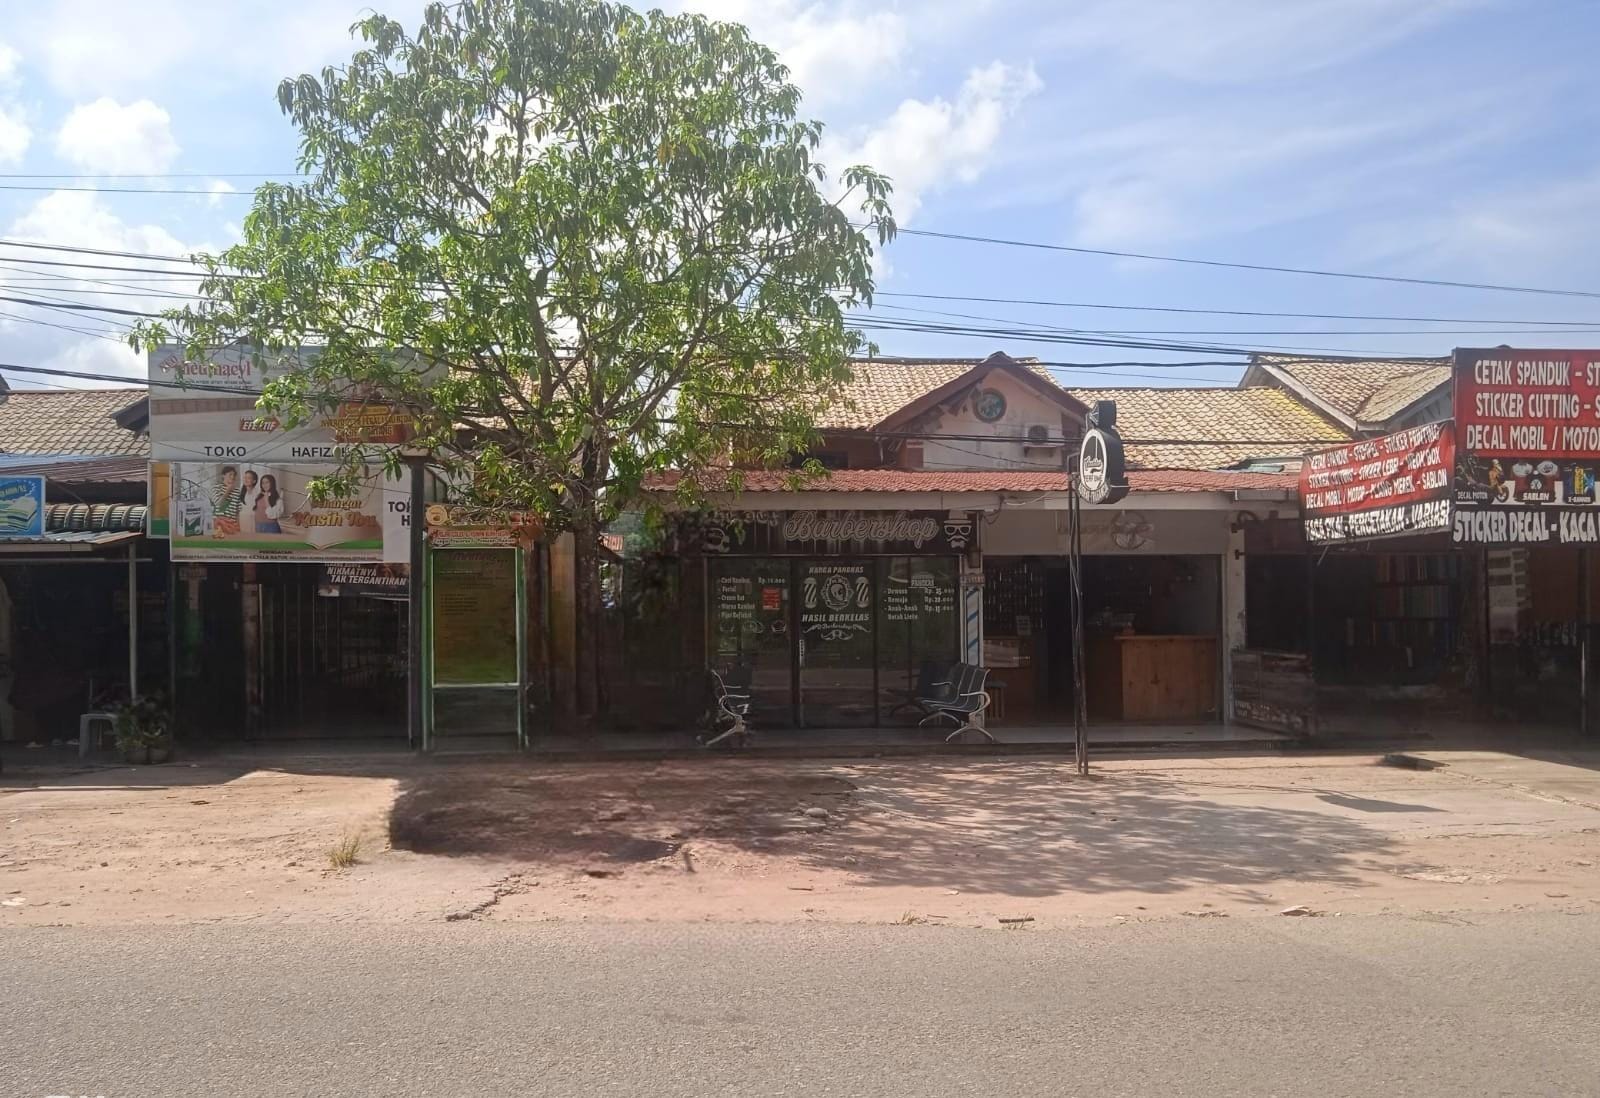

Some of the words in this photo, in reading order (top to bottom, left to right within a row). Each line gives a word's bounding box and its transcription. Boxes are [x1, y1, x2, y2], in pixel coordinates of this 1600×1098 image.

[1475, 360, 1512, 385] CETAK
[1517, 361, 1570, 386] SPANDUK
[1476, 393, 1524, 417] STICKER
[1528, 394, 1579, 418] CUTTING
[242, 420, 275, 430] EFETIF
[1466, 425, 1506, 449] DECAL
[1510, 425, 1547, 450] MOBIL
[204, 446, 247, 457] TOKO
[292, 447, 351, 458] HAFIZH
[1427, 446, 1441, 465] BOX
[1306, 492, 1323, 509] DECAL
[1325, 490, 1341, 507] MOBIL
[1421, 468, 1447, 489] SABLON
[1458, 491, 1473, 499] DECAL
[311, 500, 362, 511] hangat
[1348, 507, 1405, 536] PERCETAKAN
[1411, 500, 1450, 529] VARIASI
[1453, 511, 1507, 542] STICKER
[1509, 511, 1550, 542] DECAL
[1560, 511, 1598, 543] KACA
[783, 510, 939, 549] Barbershop
[327, 566, 377, 577] NIKMATNYA
[331, 575, 346, 583] TAK
[348, 575, 407, 586] TERGANTIKAN
[802, 614, 826, 622] HASIL
[828, 613, 870, 622] BERKELAS
